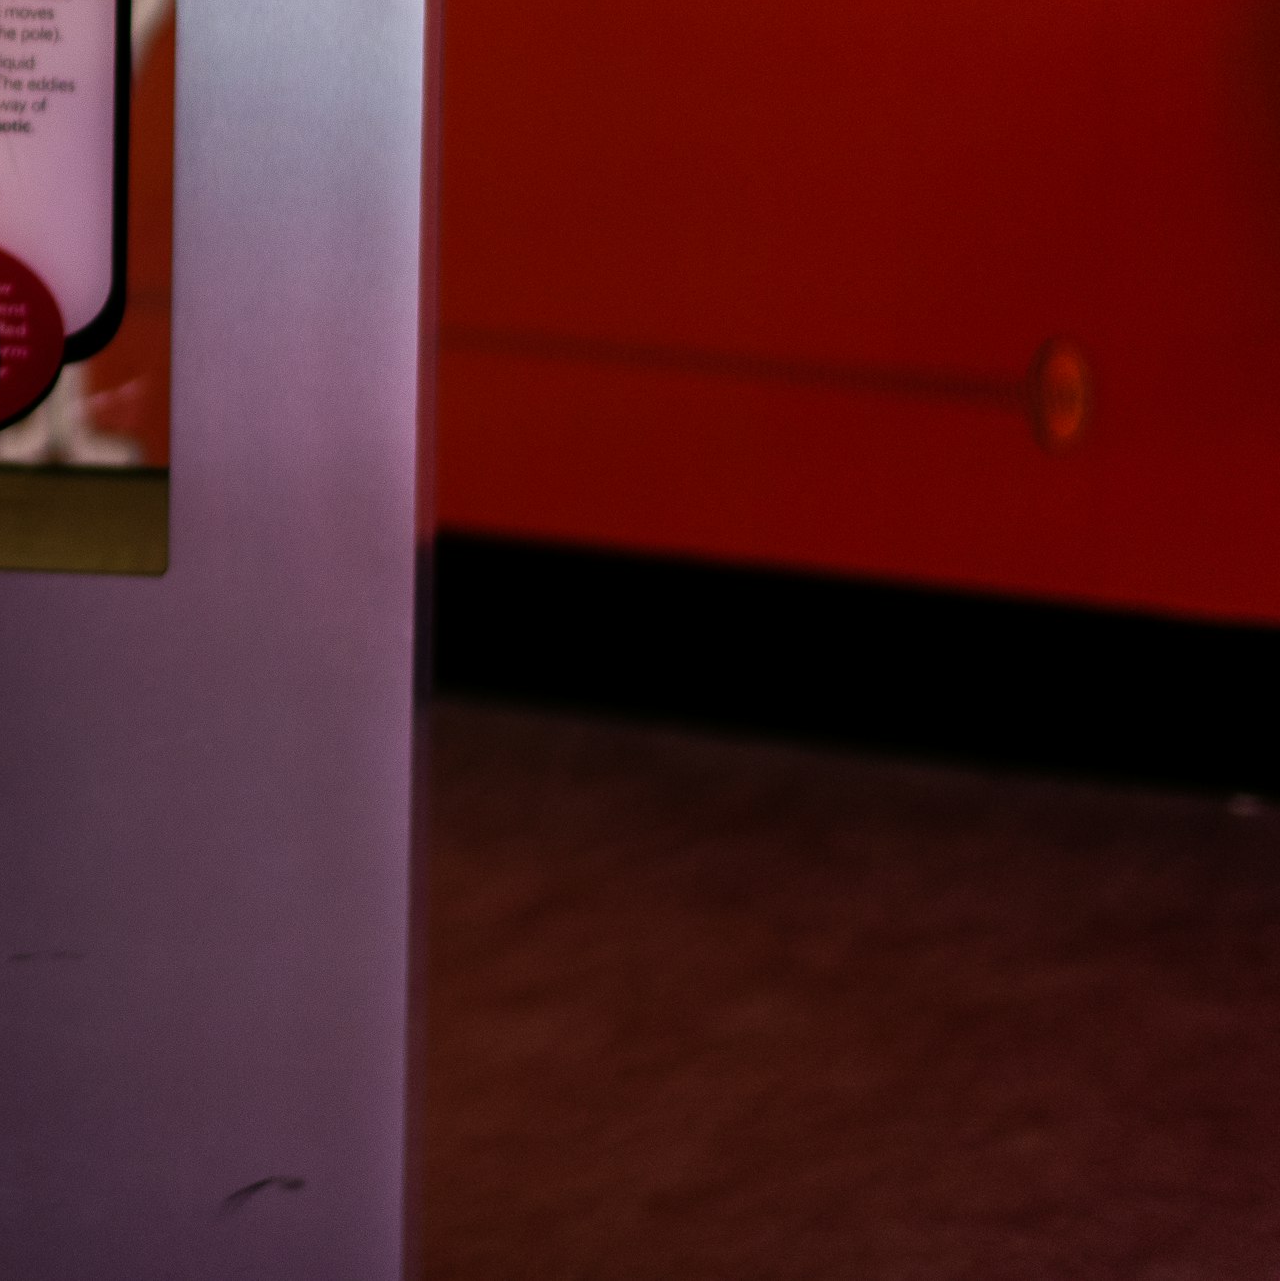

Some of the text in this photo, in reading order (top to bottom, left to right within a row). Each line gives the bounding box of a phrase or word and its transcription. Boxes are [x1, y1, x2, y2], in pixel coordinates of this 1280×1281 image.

[4, 7, 55, 21] moves
[26, 76, 76, 93] eddies
[31, 97, 48, 112] of
